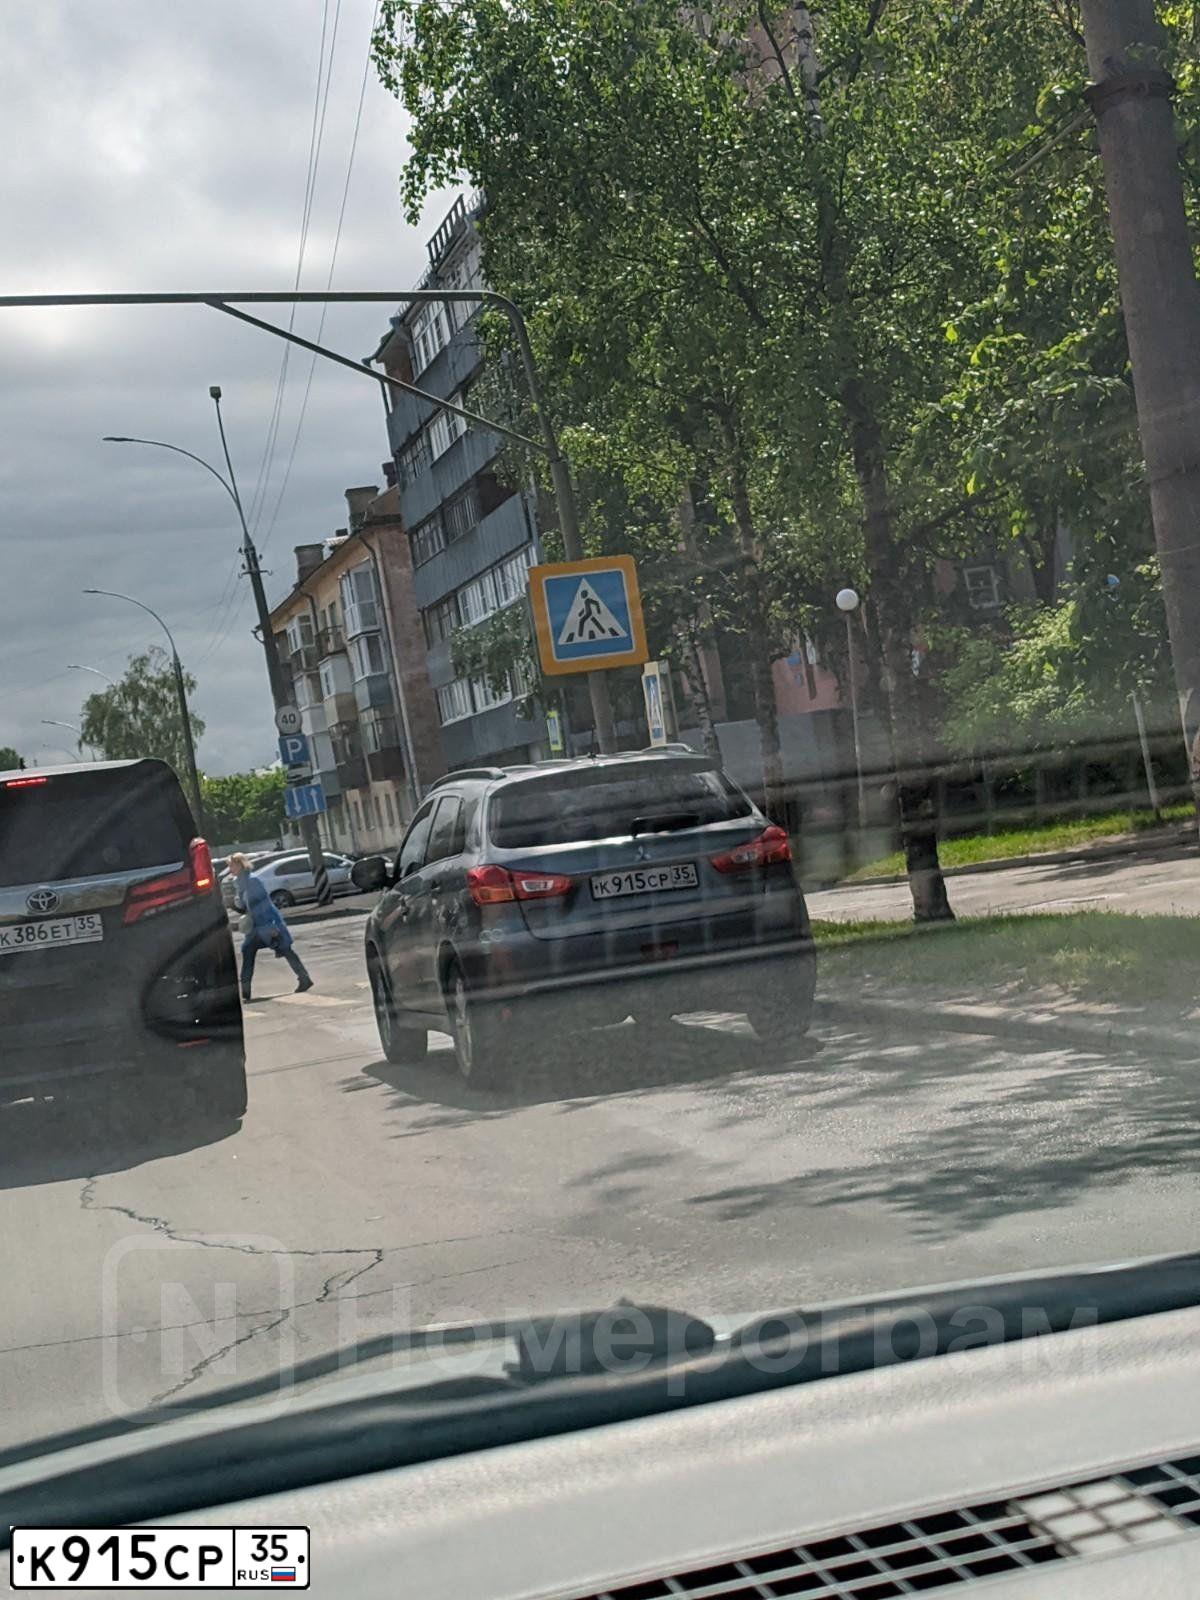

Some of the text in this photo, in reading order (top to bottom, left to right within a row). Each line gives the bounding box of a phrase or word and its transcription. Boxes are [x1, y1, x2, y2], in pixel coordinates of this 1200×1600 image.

[281, 713, 297, 724] 40
[286, 738, 303, 761] P
[673, 866, 690, 880] 35
[78, 916, 96, 930] 35
